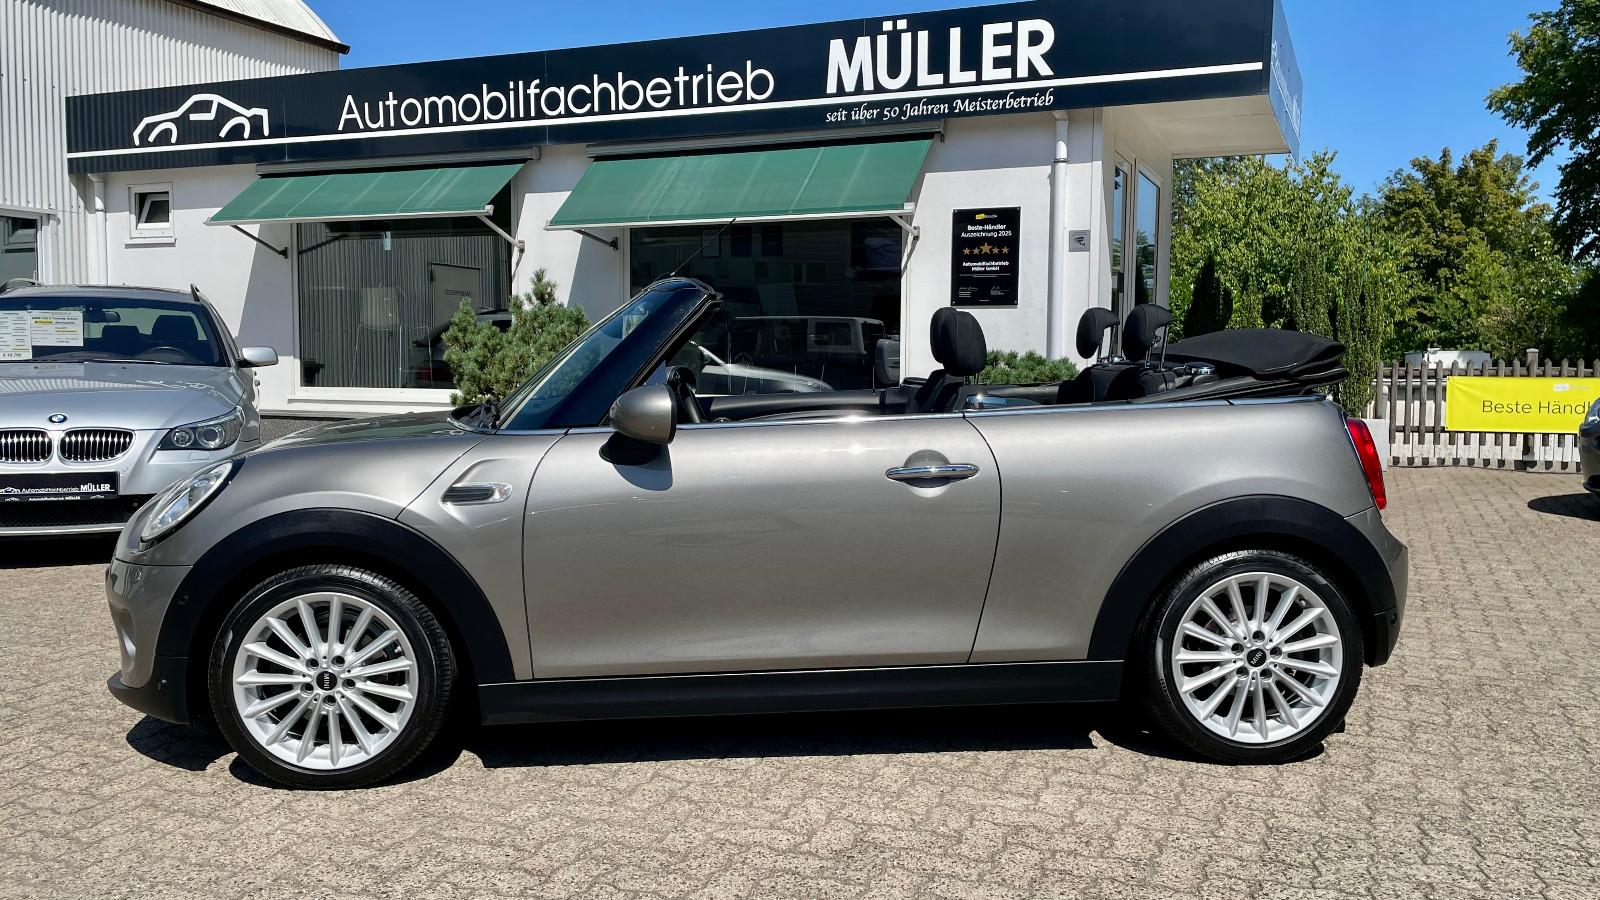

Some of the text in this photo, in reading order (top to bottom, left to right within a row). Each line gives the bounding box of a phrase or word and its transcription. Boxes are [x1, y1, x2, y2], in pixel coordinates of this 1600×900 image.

[826, 19, 1055, 94] MÜLLER
[337, 60, 775, 131] Automobilfachbetrieb
[826, 88, 1054, 122] seit über 50 Jahren Meisterbetrieb
[1482, 400, 1532, 414] Beste
[80, 483, 111, 492] MÜLLER
[1250, 651, 1263, 665] MINI
